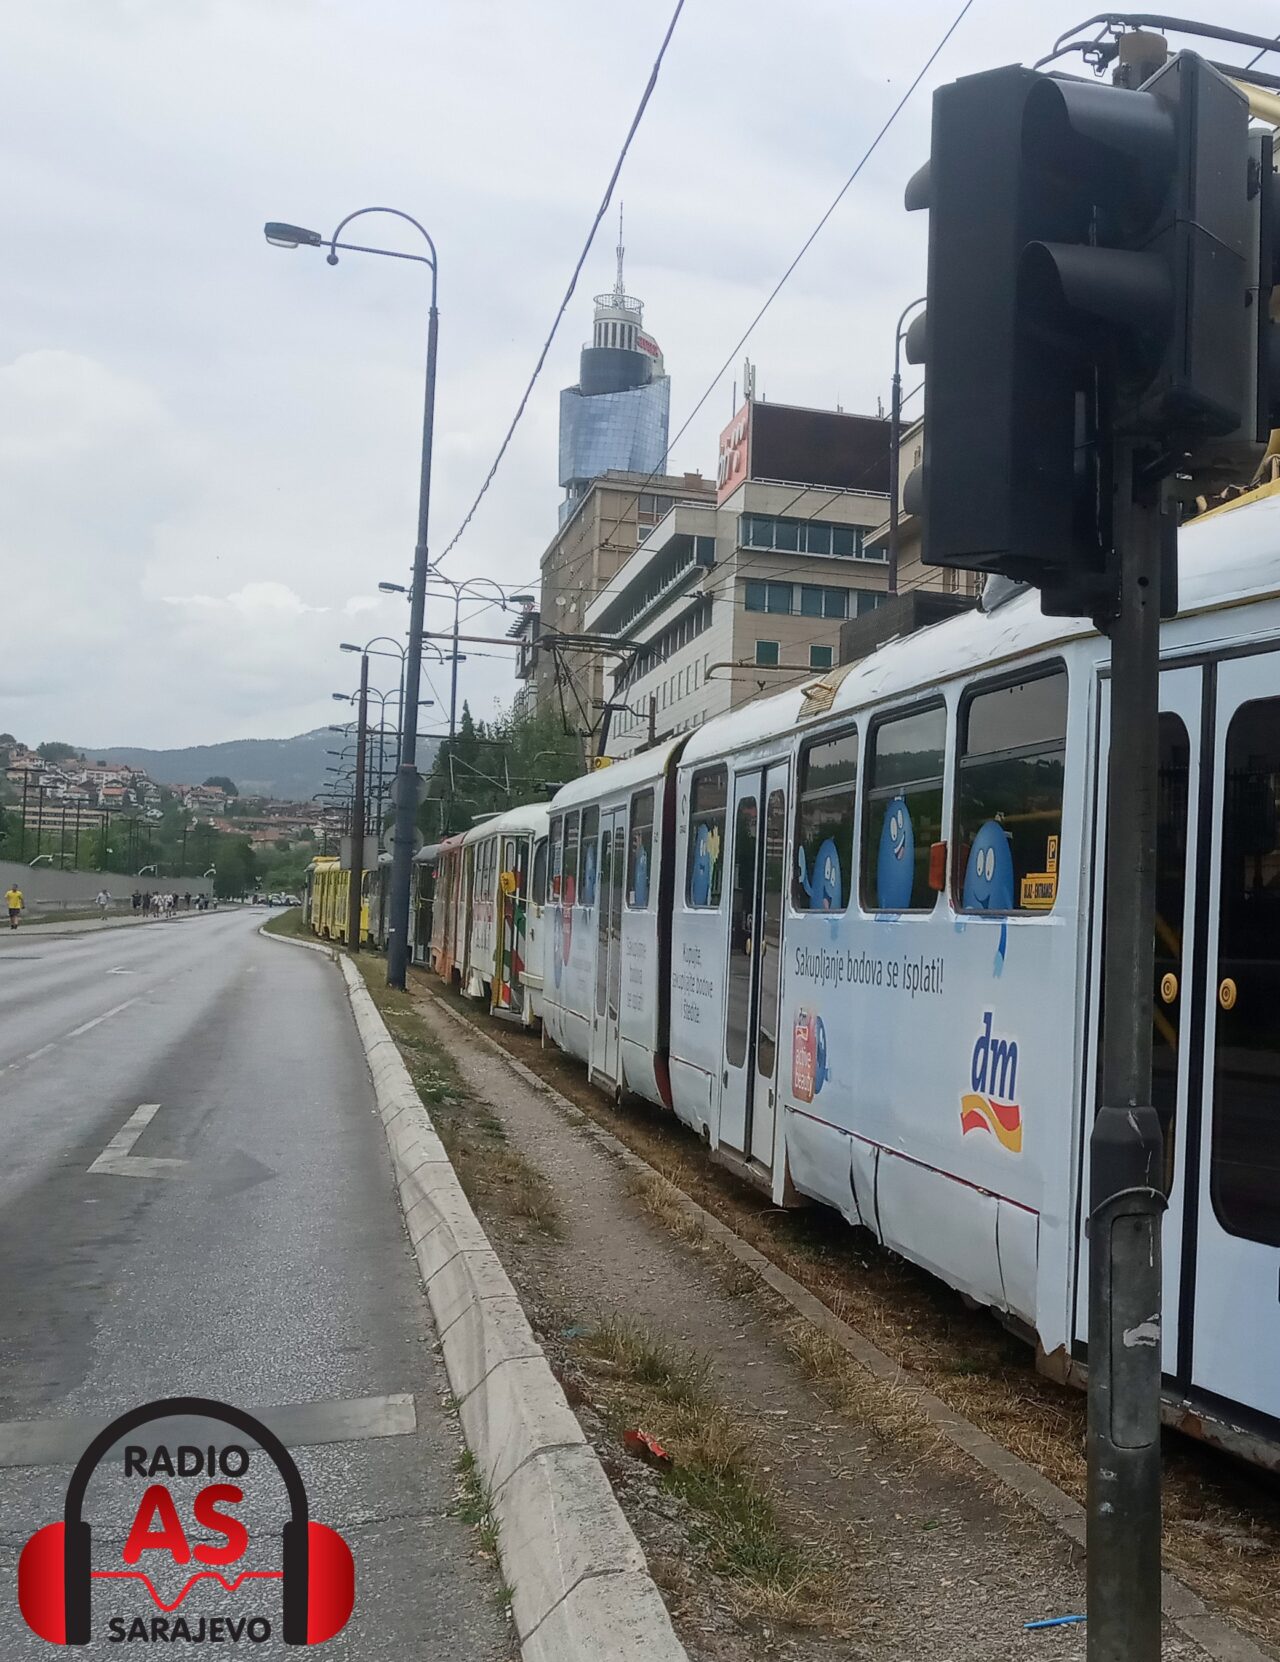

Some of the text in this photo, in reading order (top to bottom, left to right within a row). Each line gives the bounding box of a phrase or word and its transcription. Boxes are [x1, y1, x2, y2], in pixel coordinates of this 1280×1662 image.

[795, 947, 944, 999] Sakupljanje bodova se isplati!
[971, 1011, 1018, 1101] dm
